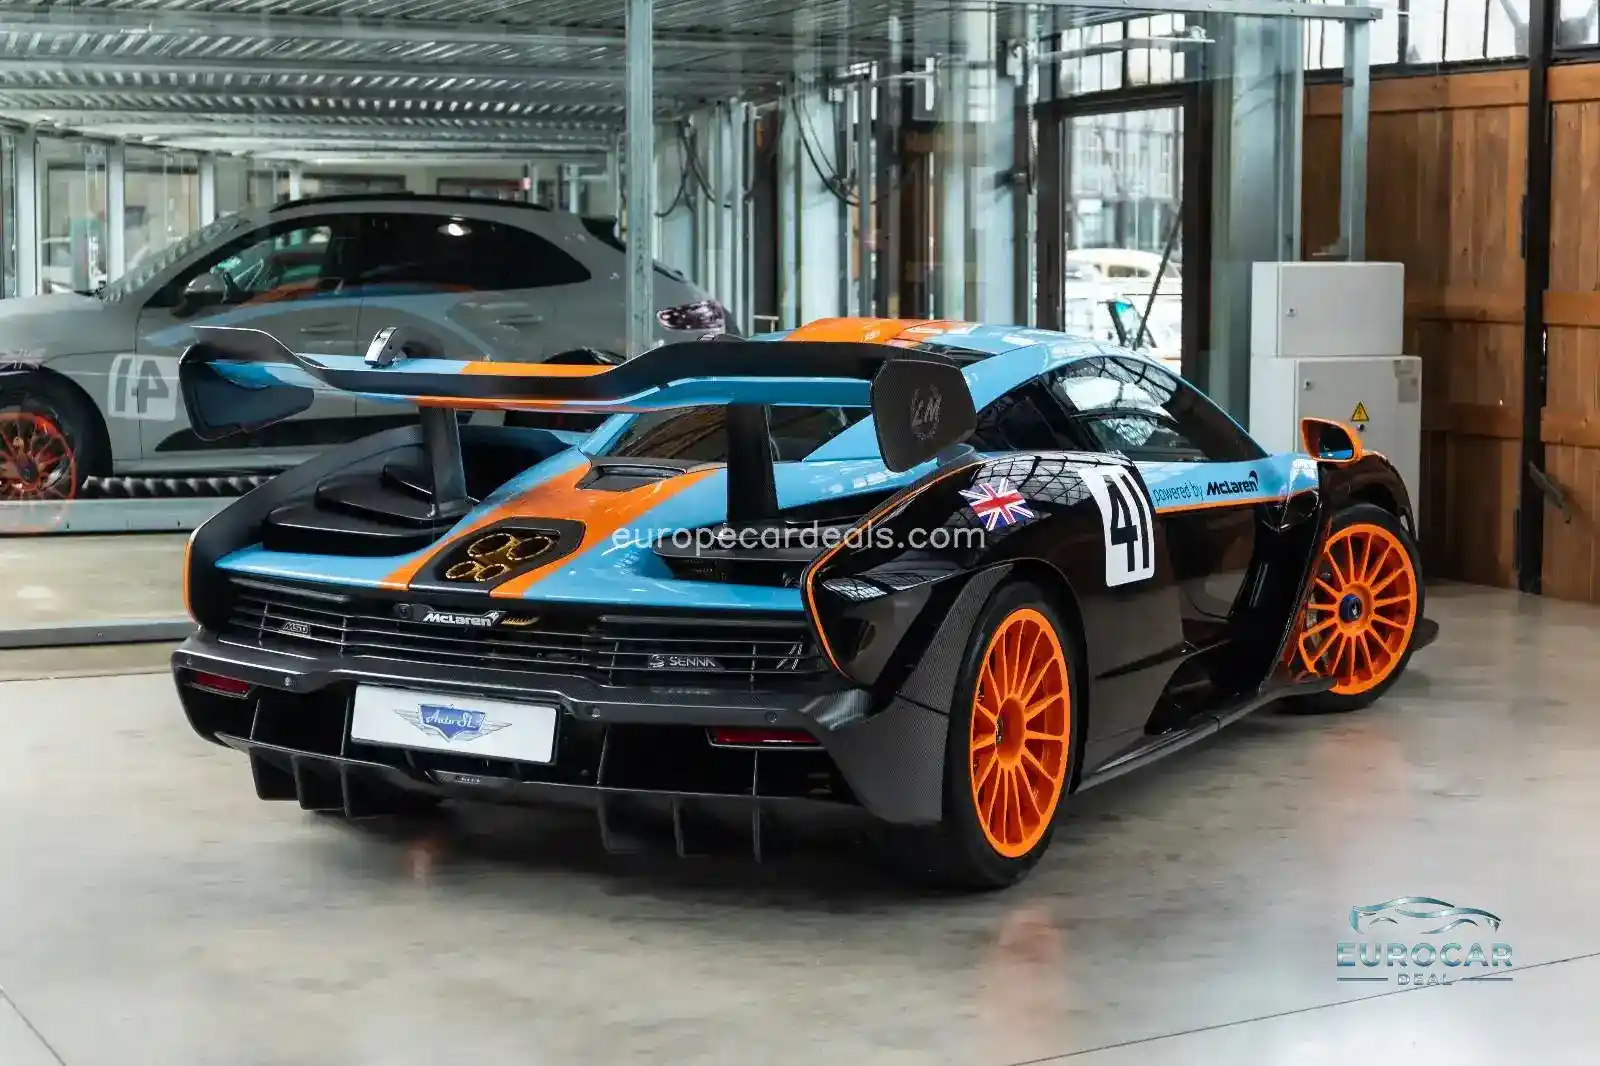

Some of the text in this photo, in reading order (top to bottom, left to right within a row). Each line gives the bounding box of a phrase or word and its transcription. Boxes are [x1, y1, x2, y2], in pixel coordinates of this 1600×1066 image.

[1152, 477, 1259, 506] powered by McLaren
[1101, 473, 1150, 573] 41
[422, 611, 496, 627] McLaren
[668, 656, 717, 669] SENNA
